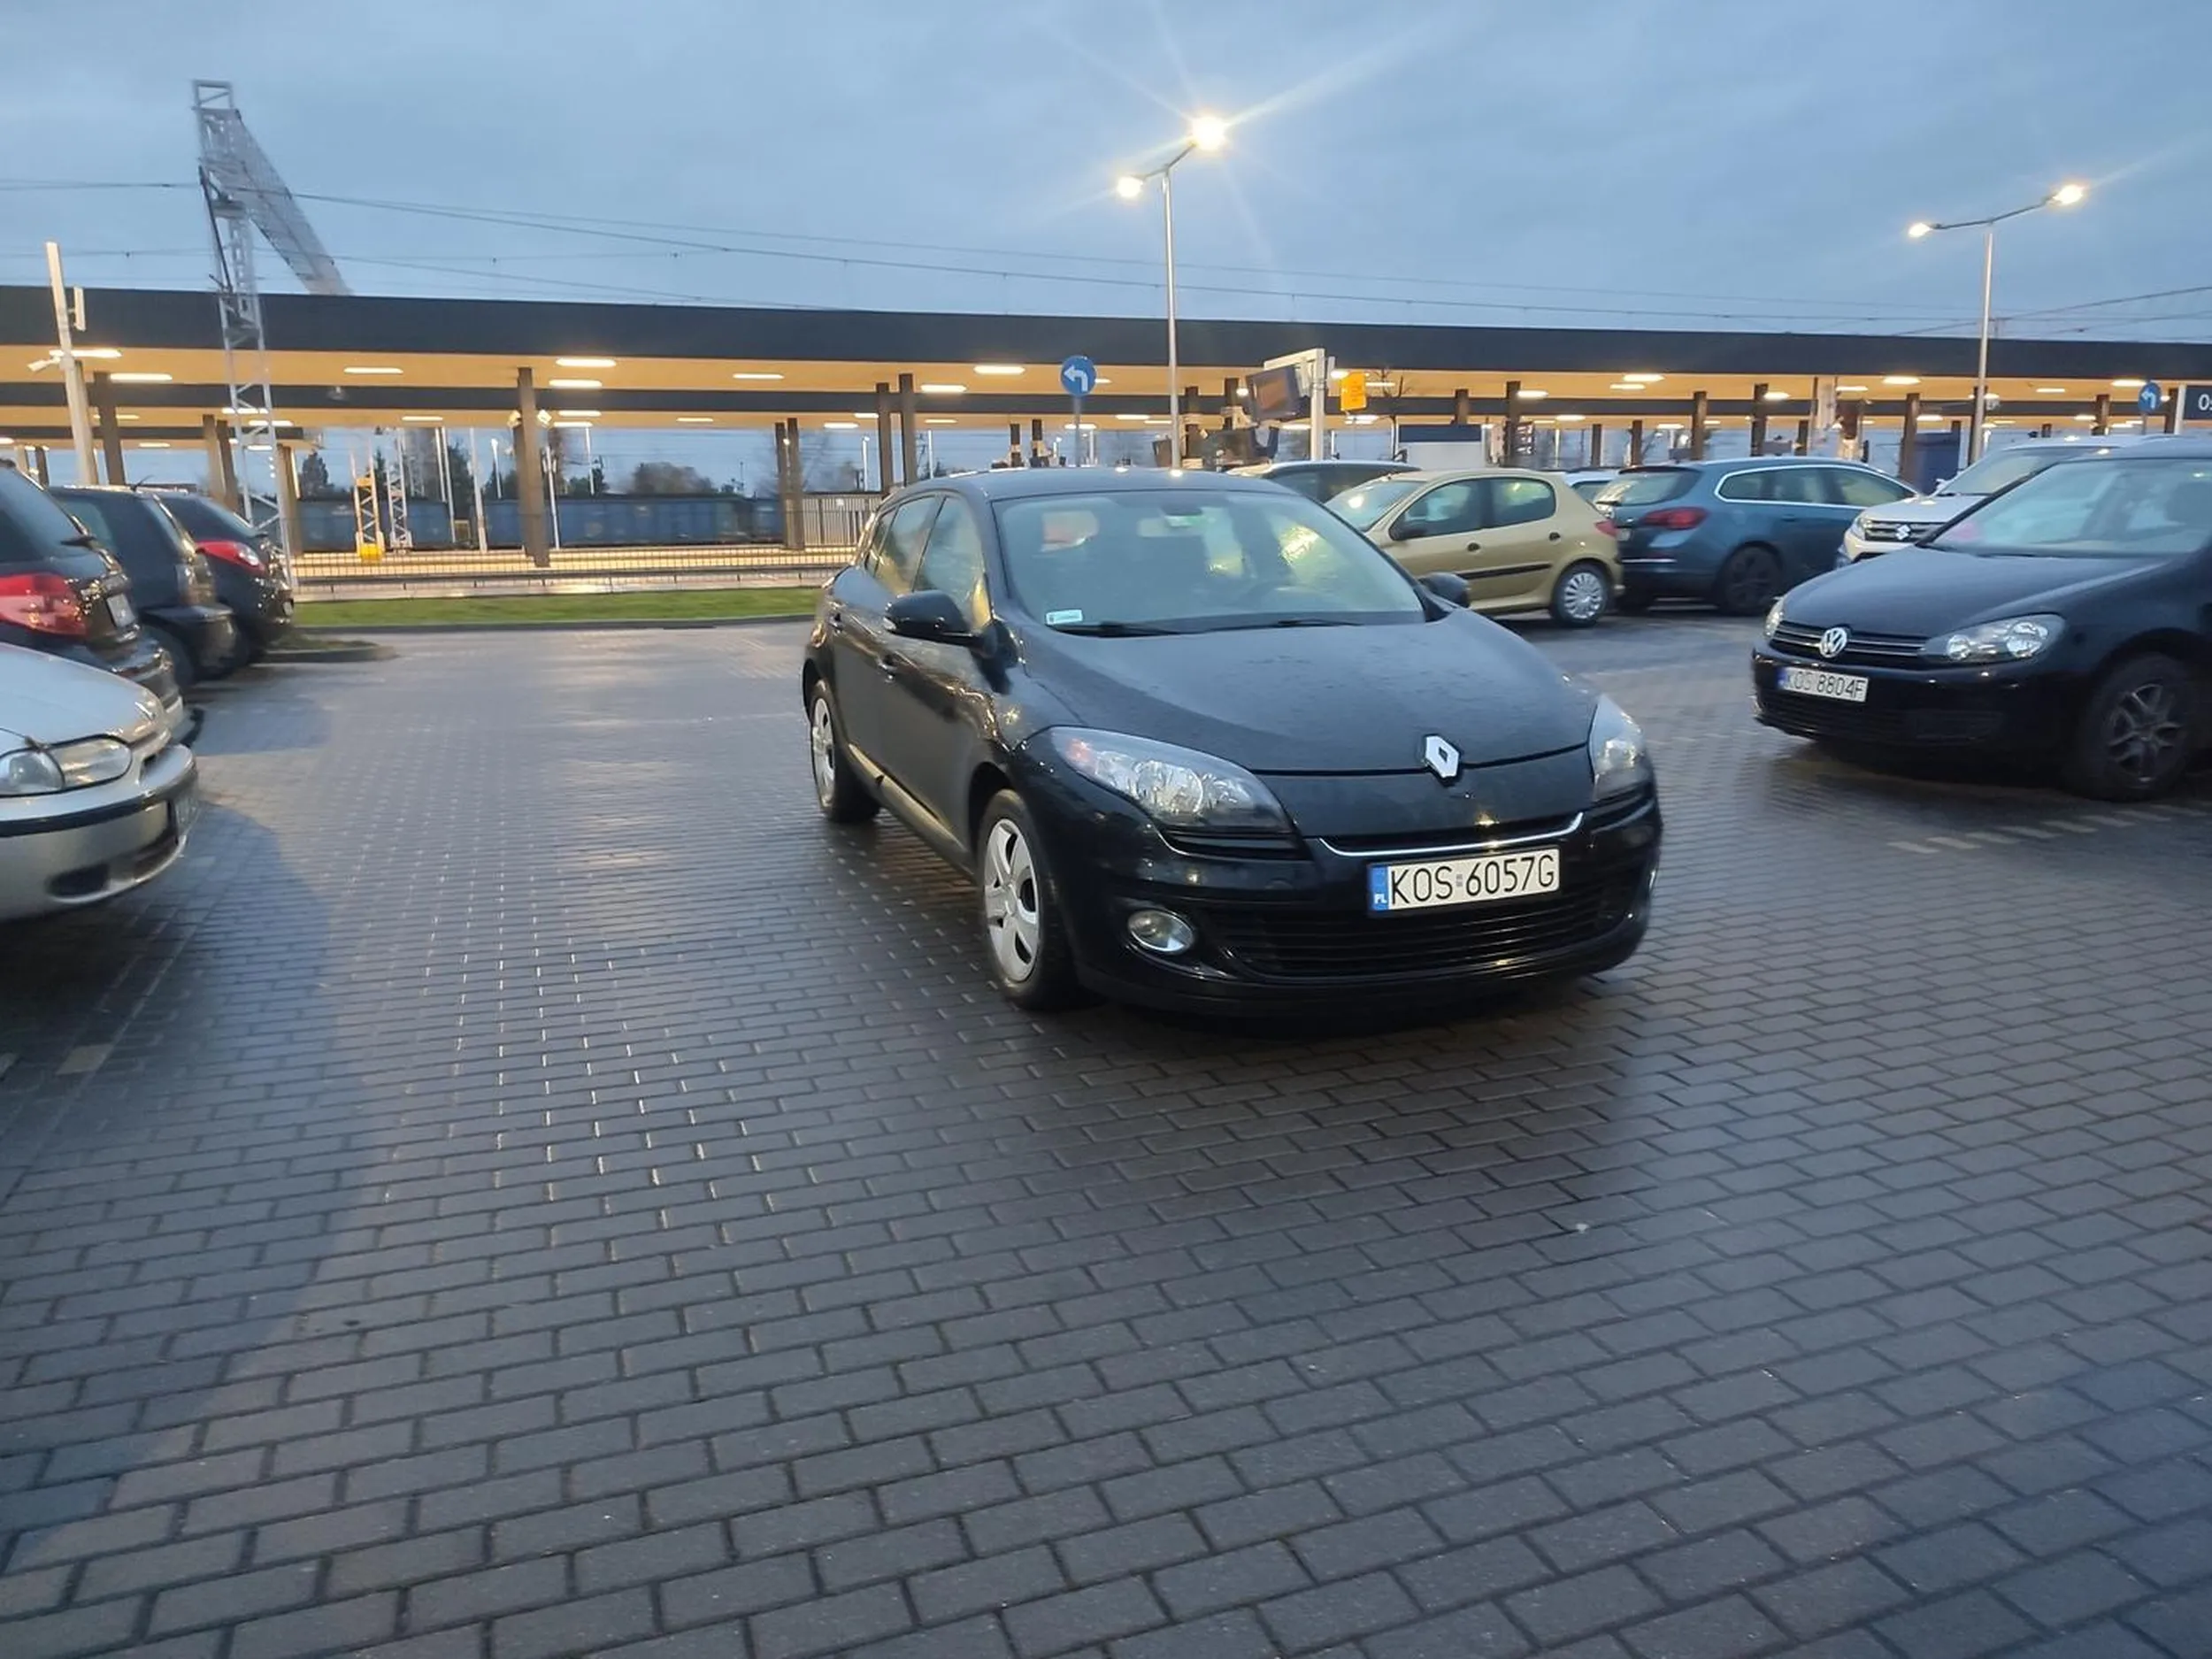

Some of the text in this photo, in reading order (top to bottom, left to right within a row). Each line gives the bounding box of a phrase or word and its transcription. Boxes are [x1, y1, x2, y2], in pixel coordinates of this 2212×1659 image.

[1816, 673, 1866, 698] 8804F
[1390, 854, 1555, 905] KOS 6057G
[1374, 893, 1387, 903] PL
